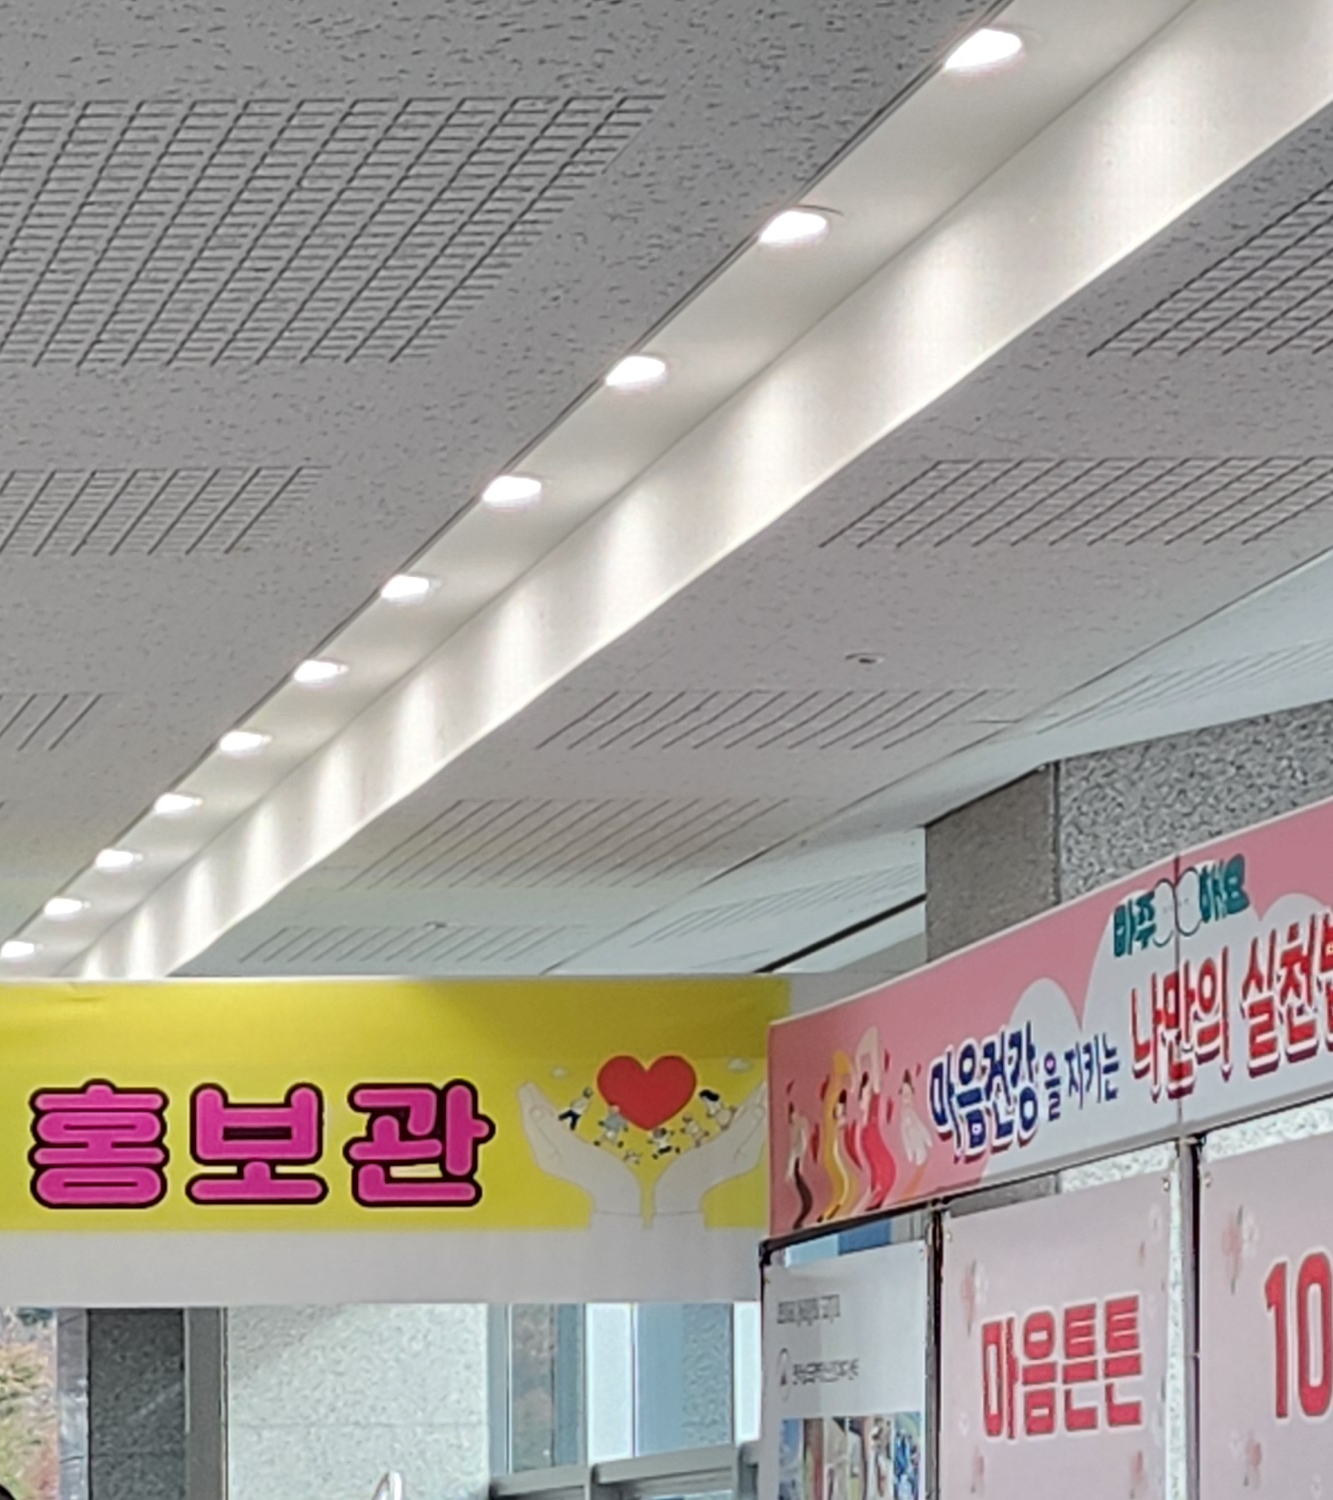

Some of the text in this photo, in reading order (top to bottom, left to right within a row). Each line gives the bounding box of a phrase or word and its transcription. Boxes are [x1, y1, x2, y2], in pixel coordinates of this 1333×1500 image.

[1064, 1033, 1120, 1110] 지키는
[1130, 946, 1232, 1103] 나만의
[28, 1078, 497, 1211] 홍보관
[980, 1293, 1144, 1441] 마음튼튼
